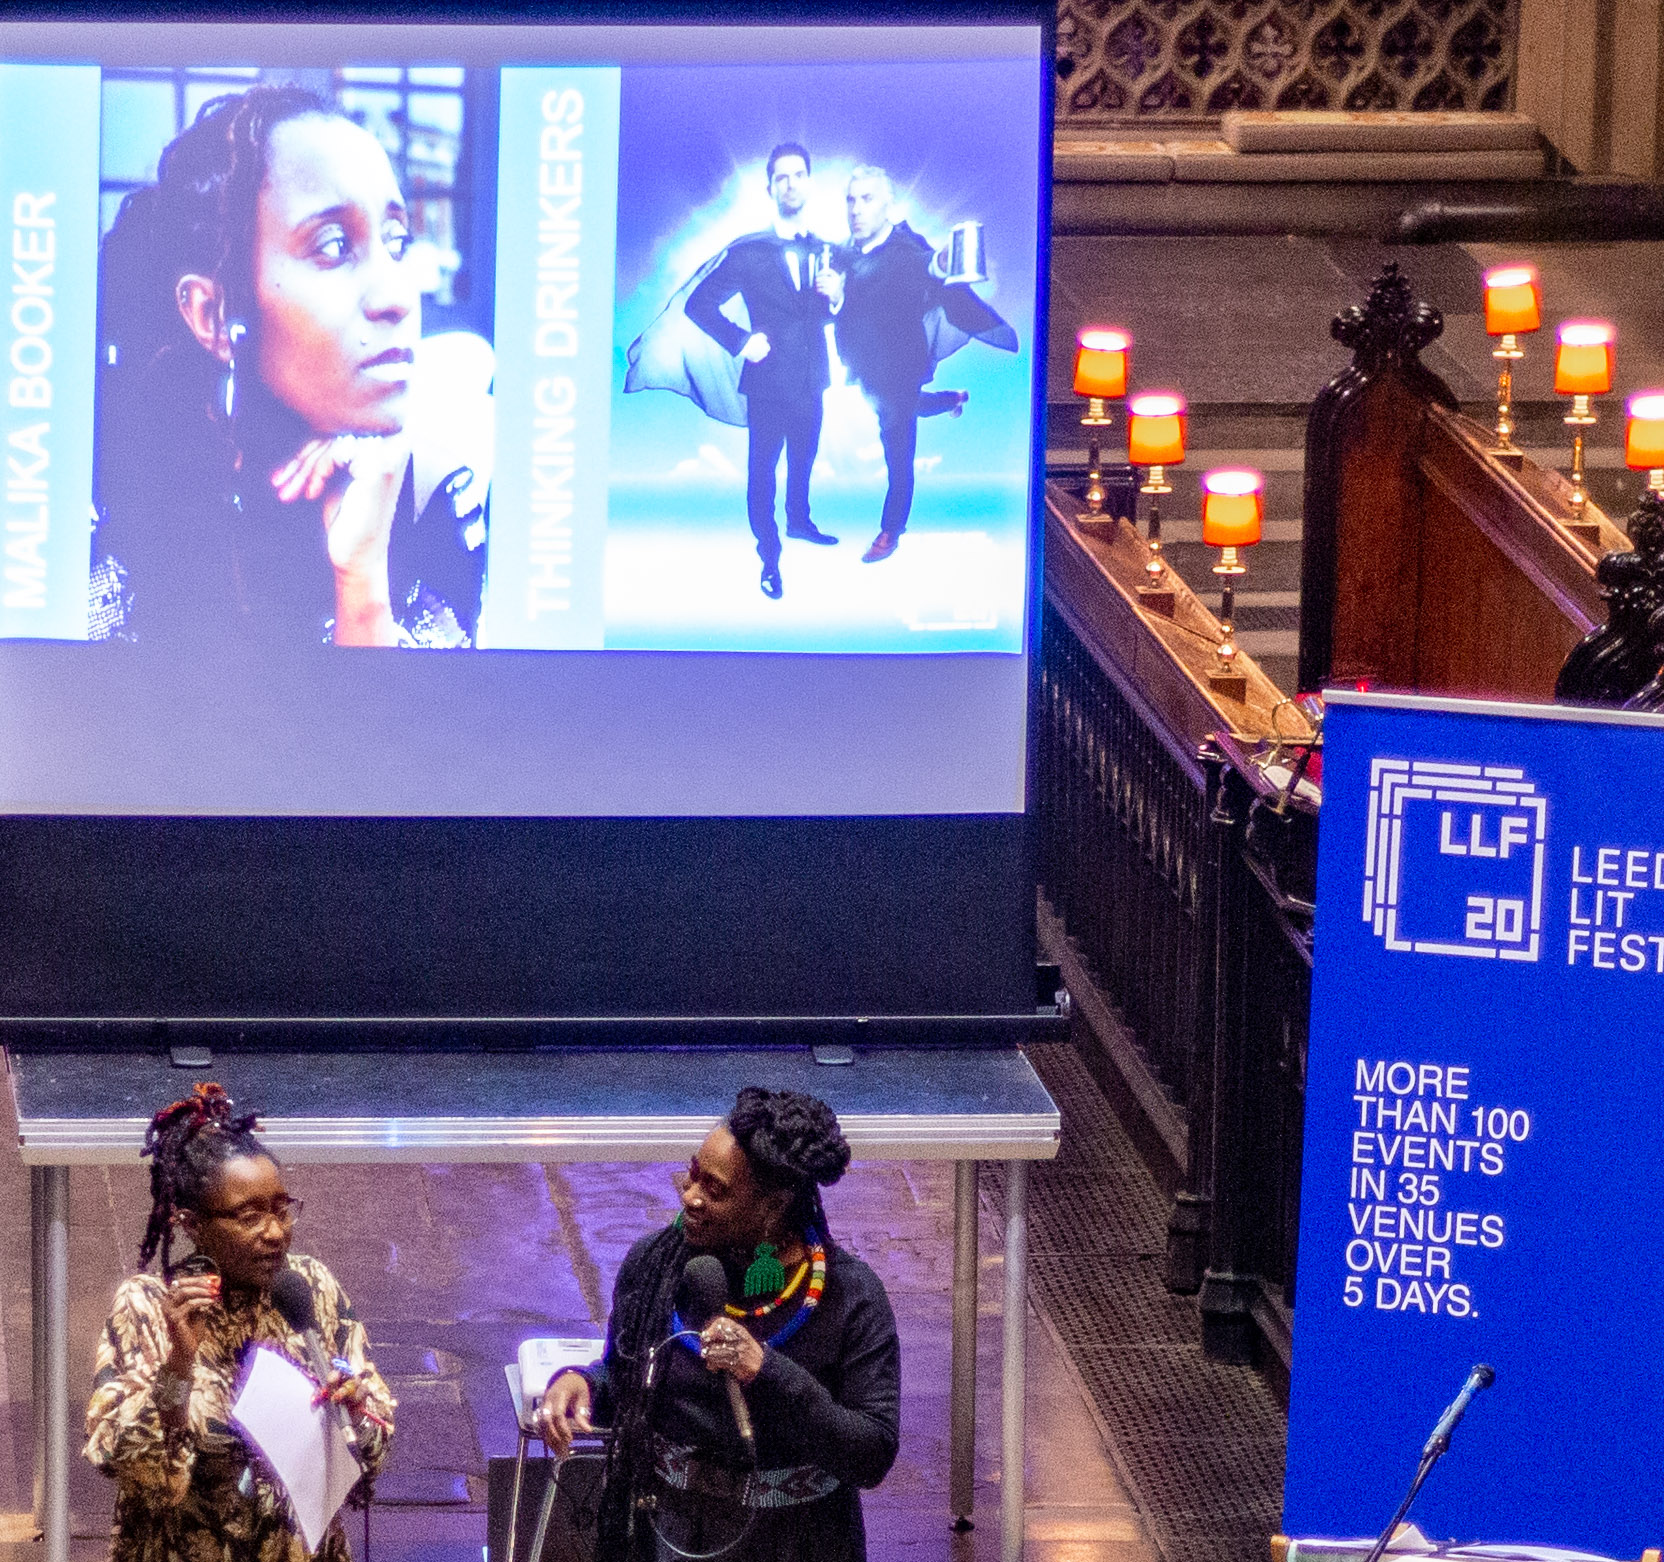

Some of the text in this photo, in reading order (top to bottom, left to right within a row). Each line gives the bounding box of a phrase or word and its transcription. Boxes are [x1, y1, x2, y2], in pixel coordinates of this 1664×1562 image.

[526, 87, 586, 622] THINKING DRINKERS
[3, 192, 56, 609] MALIKA BOOKER
[1439, 811, 1529, 859] LLF
[1465, 895, 1525, 943] 20
[1569, 887, 1635, 928] LIT
[1355, 1058, 1470, 1100] MORE
[1353, 1094, 1531, 1142] THAN 100
[1352, 1130, 1504, 1176] EVENTS
[1350, 1167, 1441, 1207] IN 35
[1348, 1202, 1505, 1249] VENUES
[1345, 1238, 1452, 1280] OVER
[1343, 1275, 1479, 1318] 5 DAYS.
